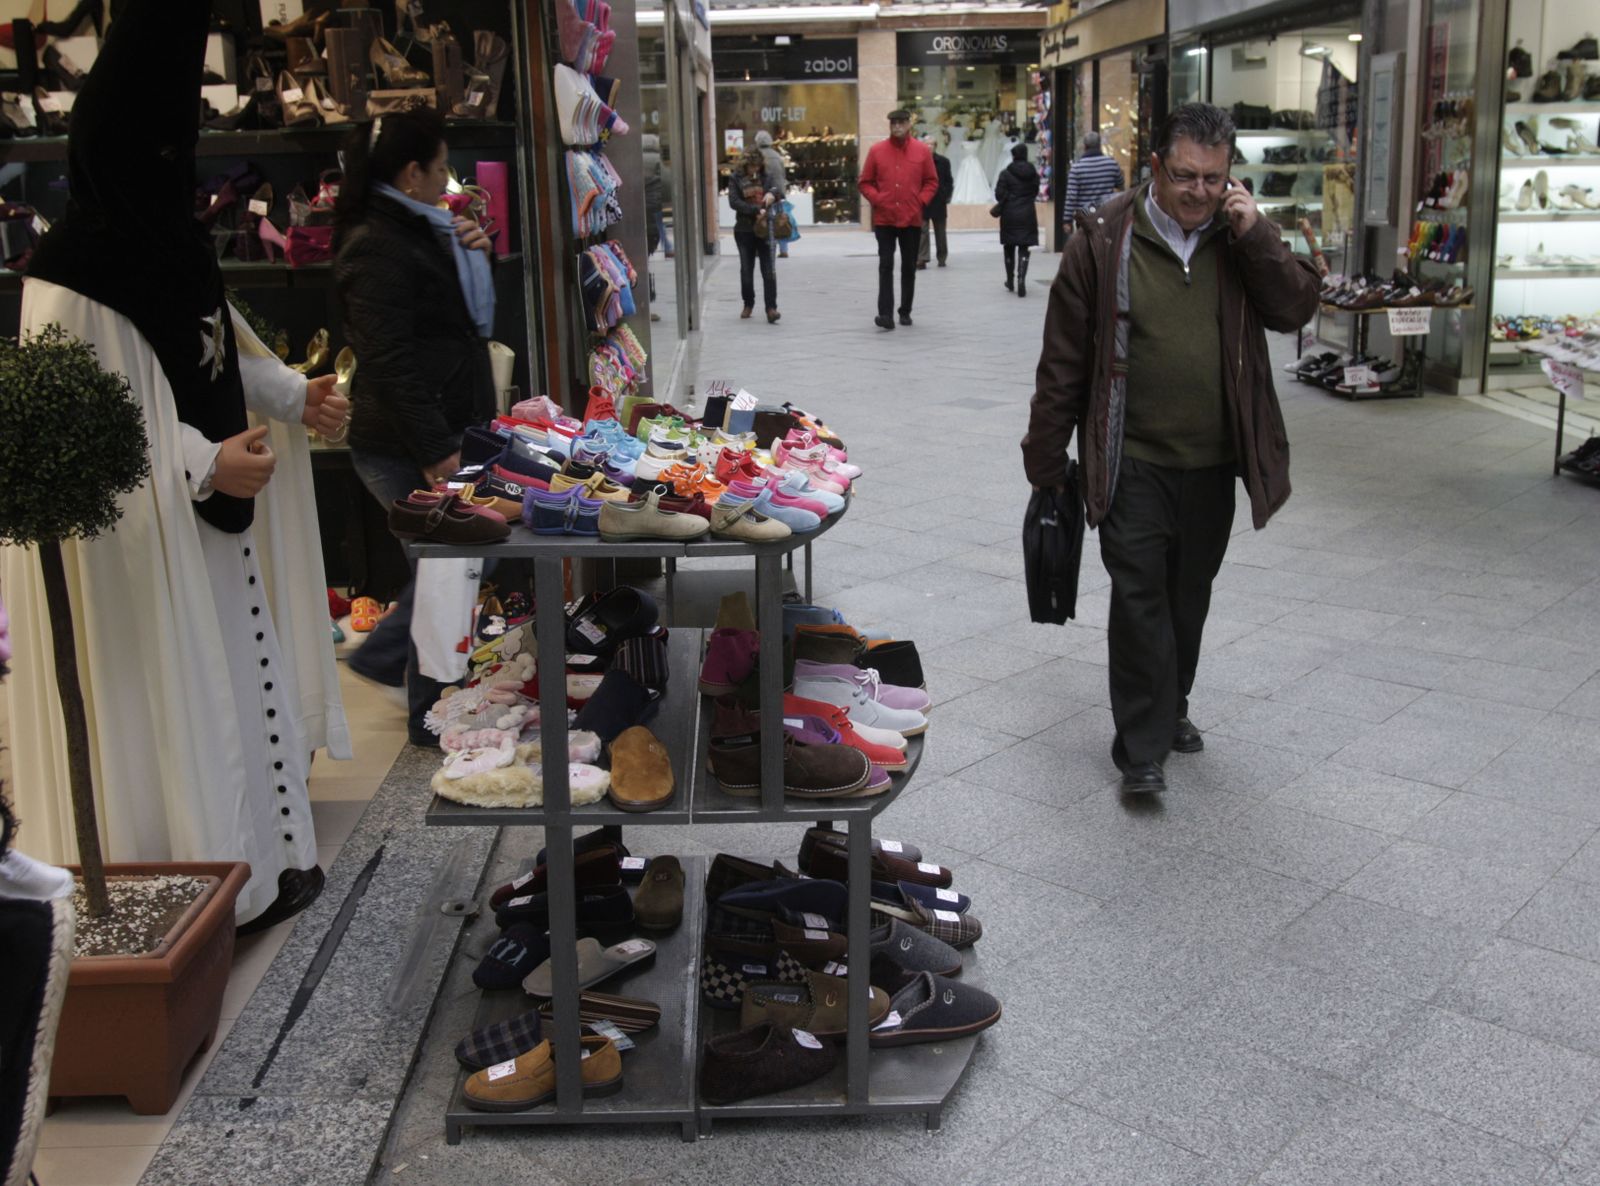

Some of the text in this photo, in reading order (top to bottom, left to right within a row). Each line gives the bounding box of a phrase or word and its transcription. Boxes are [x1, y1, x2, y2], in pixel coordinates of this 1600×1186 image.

[933, 35, 1008, 51] ORONOVIAS
[804, 56, 853, 73] zabol
[761, 107, 807, 122] OUT-LET
